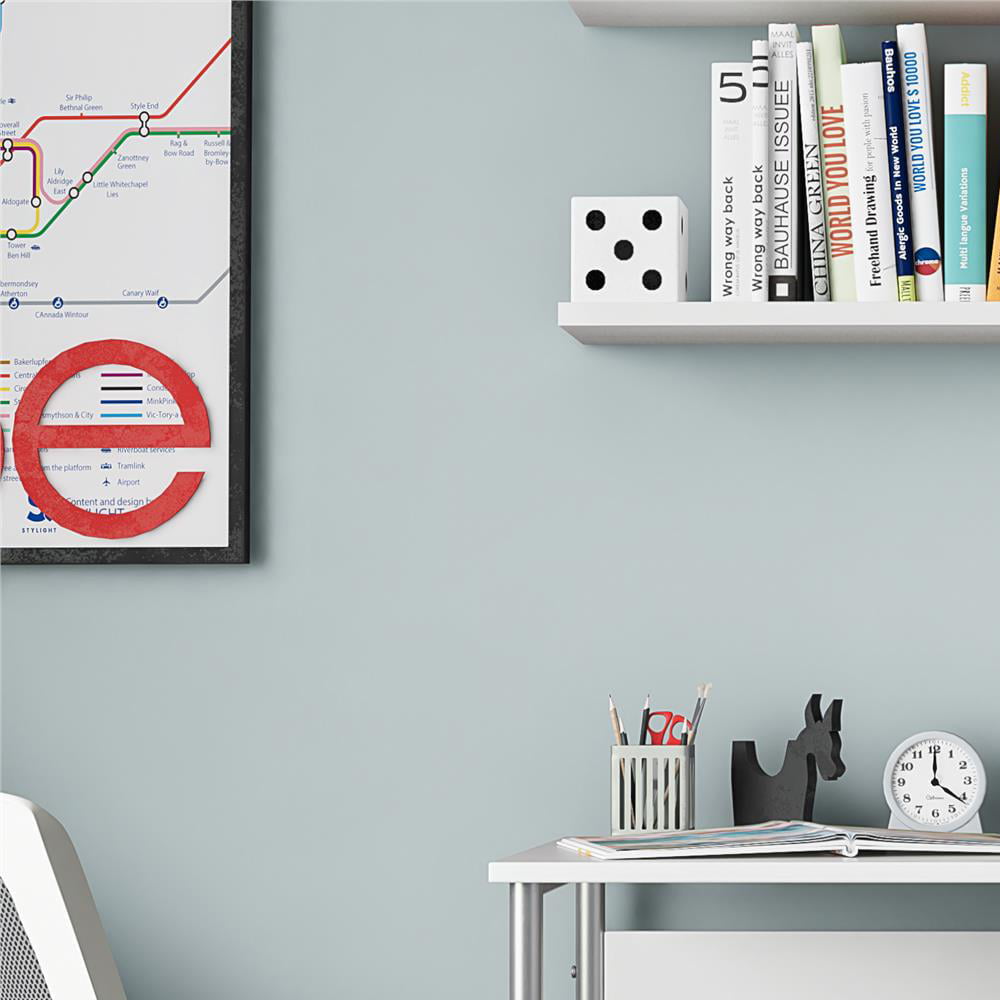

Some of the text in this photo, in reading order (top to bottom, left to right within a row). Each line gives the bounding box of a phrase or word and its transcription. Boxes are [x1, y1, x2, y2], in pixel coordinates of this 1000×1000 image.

[773, 41, 792, 49] INVIT
[884, 48, 895, 93] Bauhos
[904, 51, 919, 87] 10000
[719, 72, 747, 103] 5
[960, 71, 970, 107] Addict
[75, 94, 93, 102] Philip
[130, 103, 146, 111] Style
[907, 98, 922, 126] LOVE
[909, 127, 923, 151] YOU
[774, 80, 789, 270] BAUHAUSE ISSUEE
[911, 153, 926, 193] WORLD
[111, 181, 149, 189] Whitechapel
[821, 104, 854, 259] WORLD YOU LOVE
[890, 126, 909, 260] Alergic Goods New World
[805, 143, 828, 296] CHINA GREEN
[959, 167, 971, 269] Multi langue Variations
[752, 164, 765, 292] Wrong way back
[864, 174, 882, 287] Freehand Drawing
[722, 176, 736, 297] Wrong way back
[63, 464, 92, 472] platform
[117, 478, 140, 487] Airport
[99, 497, 116, 506] and
[117, 497, 144, 508] design
[912, 750, 923, 759] 11
[948, 749, 954, 759] 1
[900, 762, 913, 771] 10
[958, 760, 967, 770] 2
[897, 778, 906, 787] 9
[963, 776, 972, 785] 3
[903, 793, 911, 803] 8
[915, 805, 923, 814] 7
[931, 808, 940, 818] 6
[948, 804, 956, 813] 5
